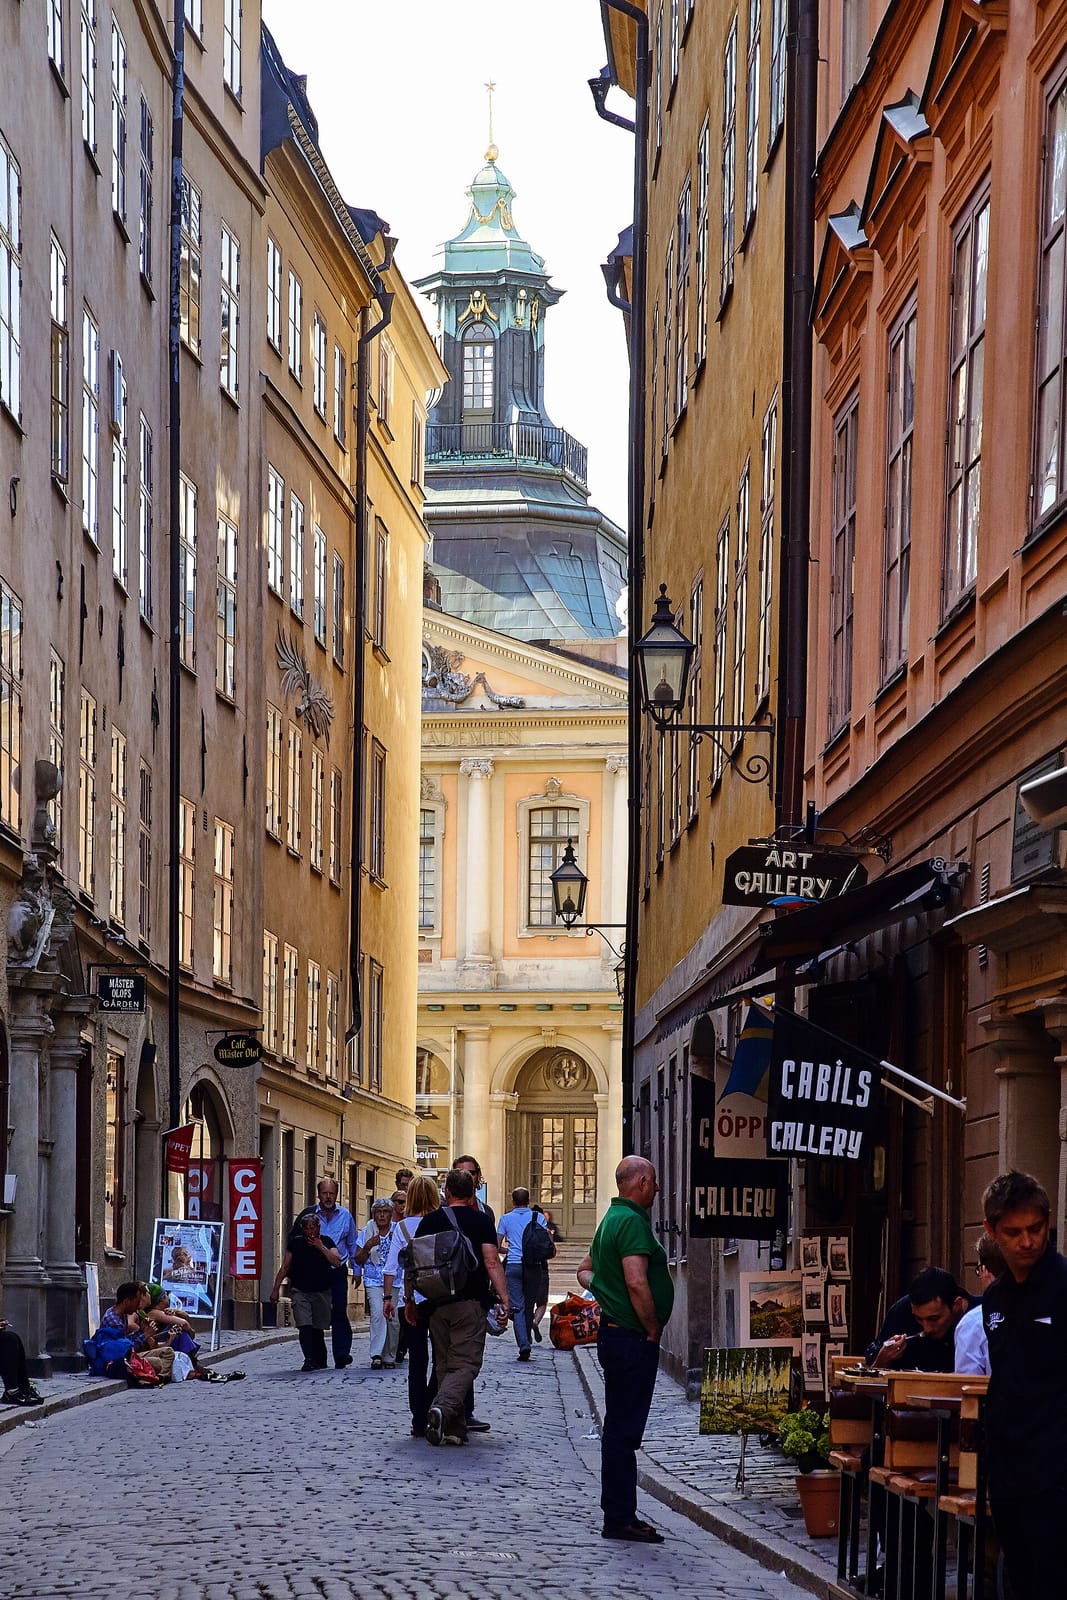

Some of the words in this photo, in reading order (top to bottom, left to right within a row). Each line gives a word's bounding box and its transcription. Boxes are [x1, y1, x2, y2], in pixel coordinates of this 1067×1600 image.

[765, 849, 813, 870] ART
[735, 871, 833, 899] GALLERY
[103, 999, 140, 1008] GÅRDEN
[112, 988, 132, 998] OLOFS
[231, 1039, 246, 1049] Café
[245, 1048, 260, 1058] Olof
[771, 1121, 863, 1159] GALLERY
[695, 1187, 776, 1219] GALLERY
[233, 1169, 258, 1275] CAFE
